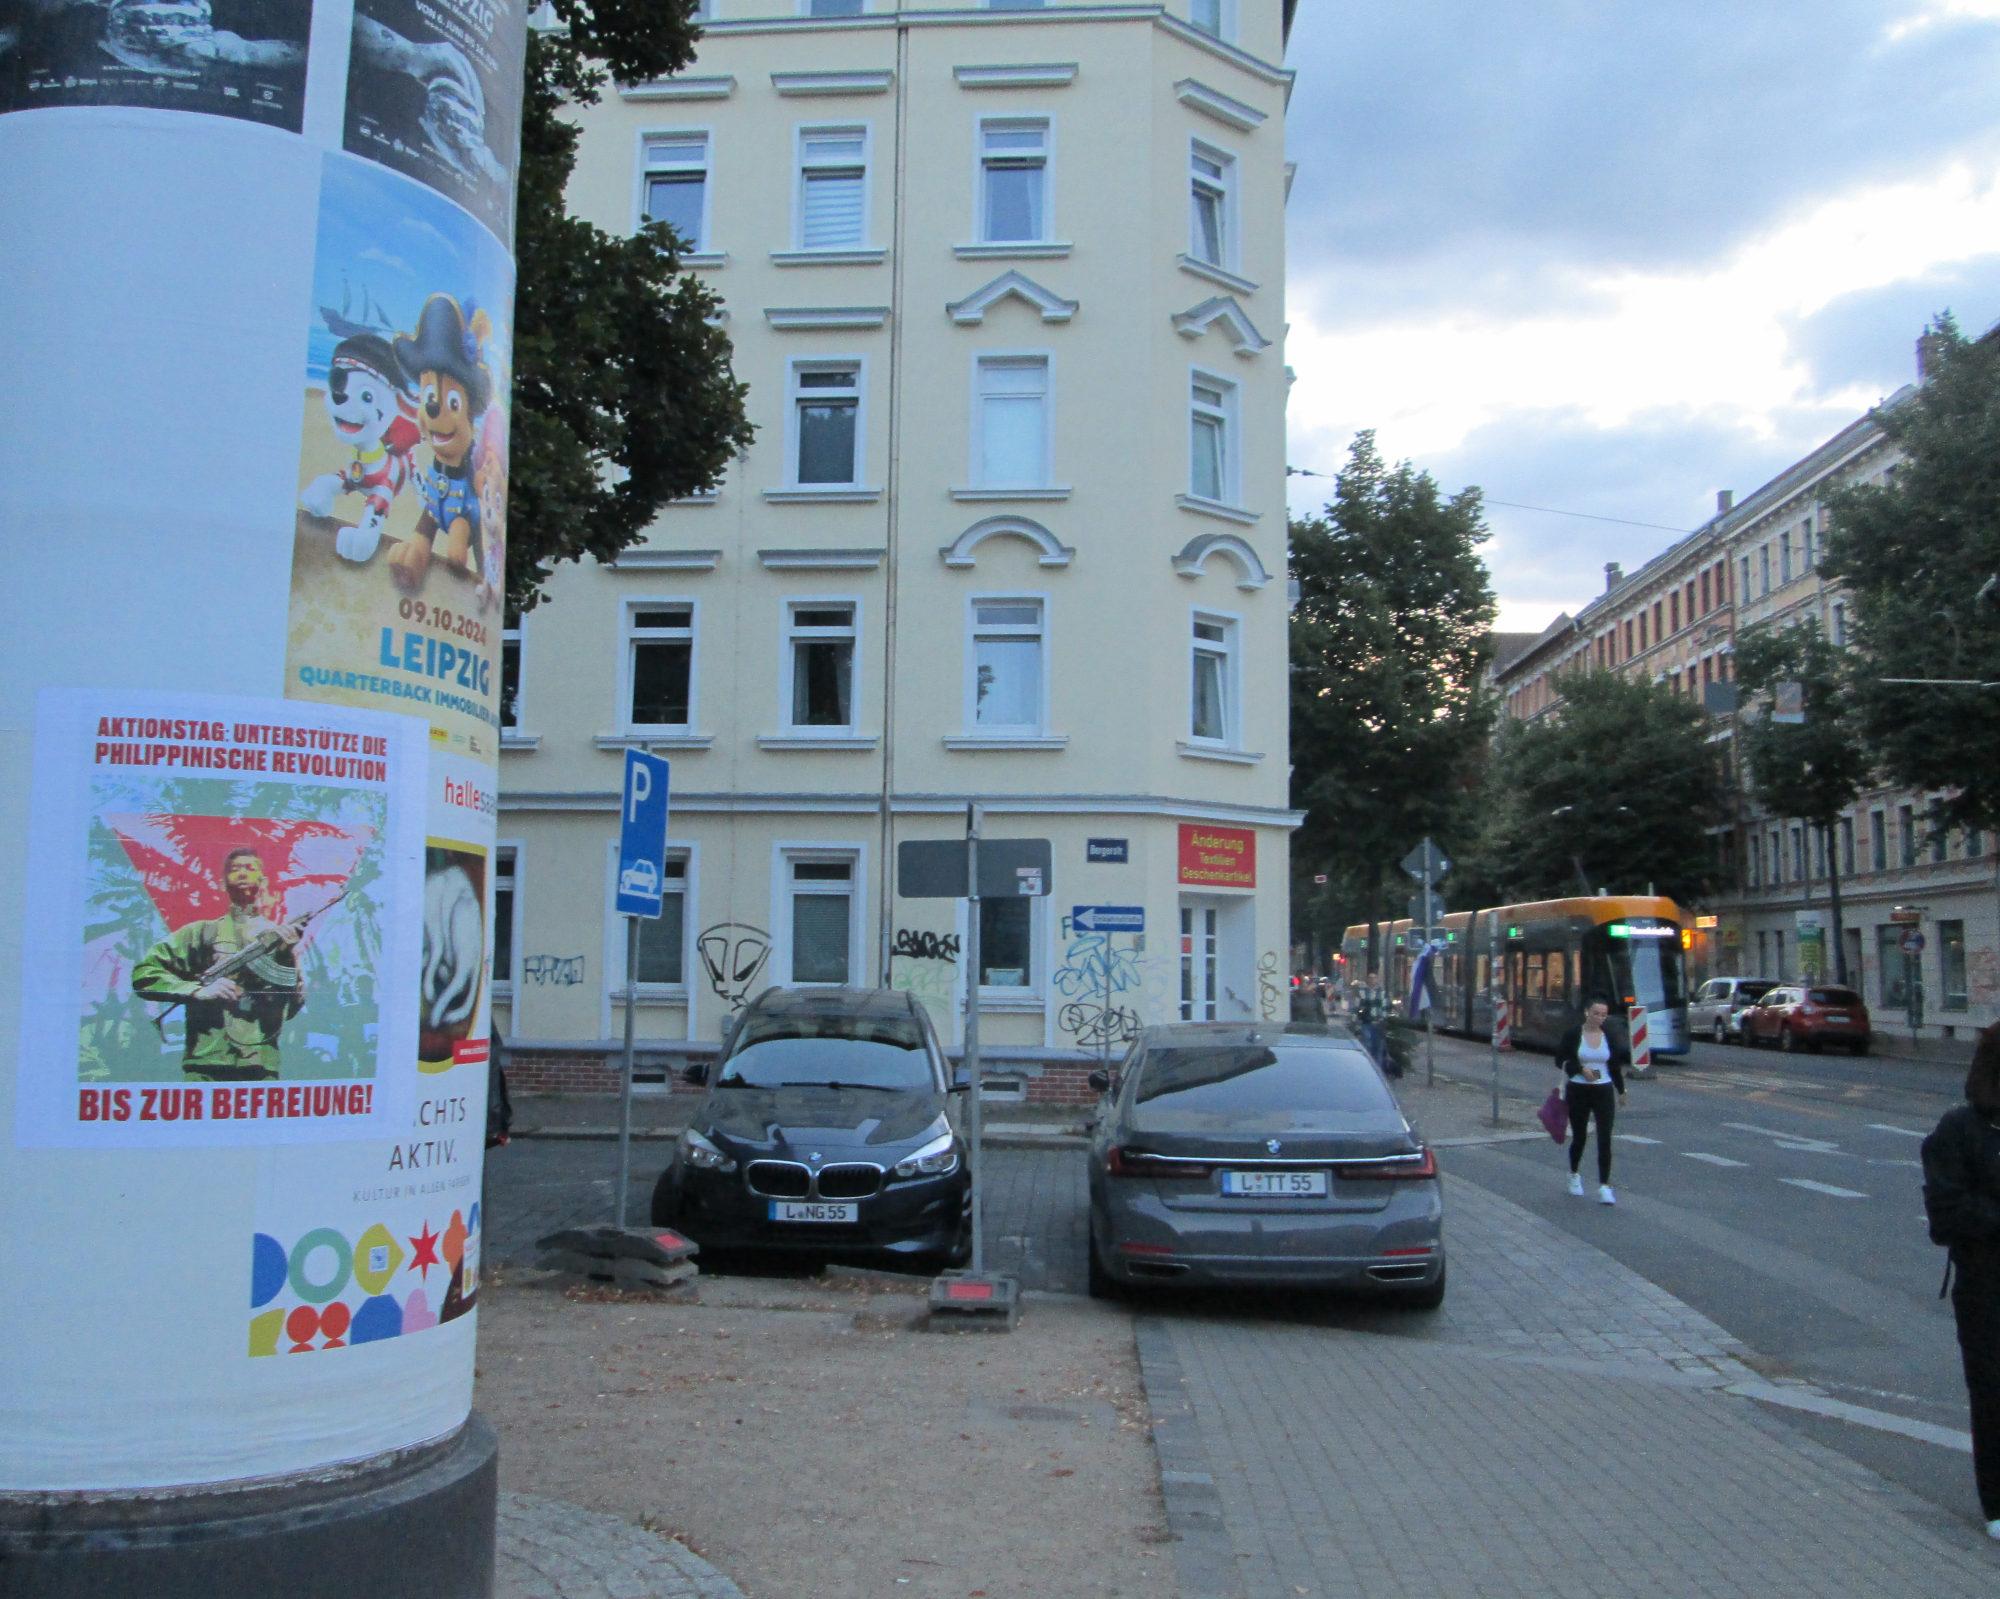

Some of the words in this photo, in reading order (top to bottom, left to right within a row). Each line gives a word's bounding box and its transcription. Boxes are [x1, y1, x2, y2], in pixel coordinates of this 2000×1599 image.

[400, 597, 487, 646] 09.10.2024
[380, 626, 490, 696] LEIPZIG
[299, 665, 432, 704] QUARTERBACK
[98, 717, 229, 742] AKTIONSTAG:
[233, 723, 358, 753] UNTERSTÜTZE
[362, 735, 387, 756] DIE
[95, 742, 267, 772] PHILIPPINISCHE
[272, 752, 386, 782] REVOLUTION
[629, 761, 652, 823] P
[1191, 829, 1245, 853] Änderung
[1199, 851, 1236, 867] Textilien
[1181, 866, 1252, 883] Geschenkartikel
[79, 1088, 131, 1121] BIS
[140, 1088, 203, 1121] ZUR
[211, 1084, 373, 1120] BEFREIUNG!
[388, 1139, 458, 1171] AKTIV.
[353, 1187, 400, 1202] KULTUR
